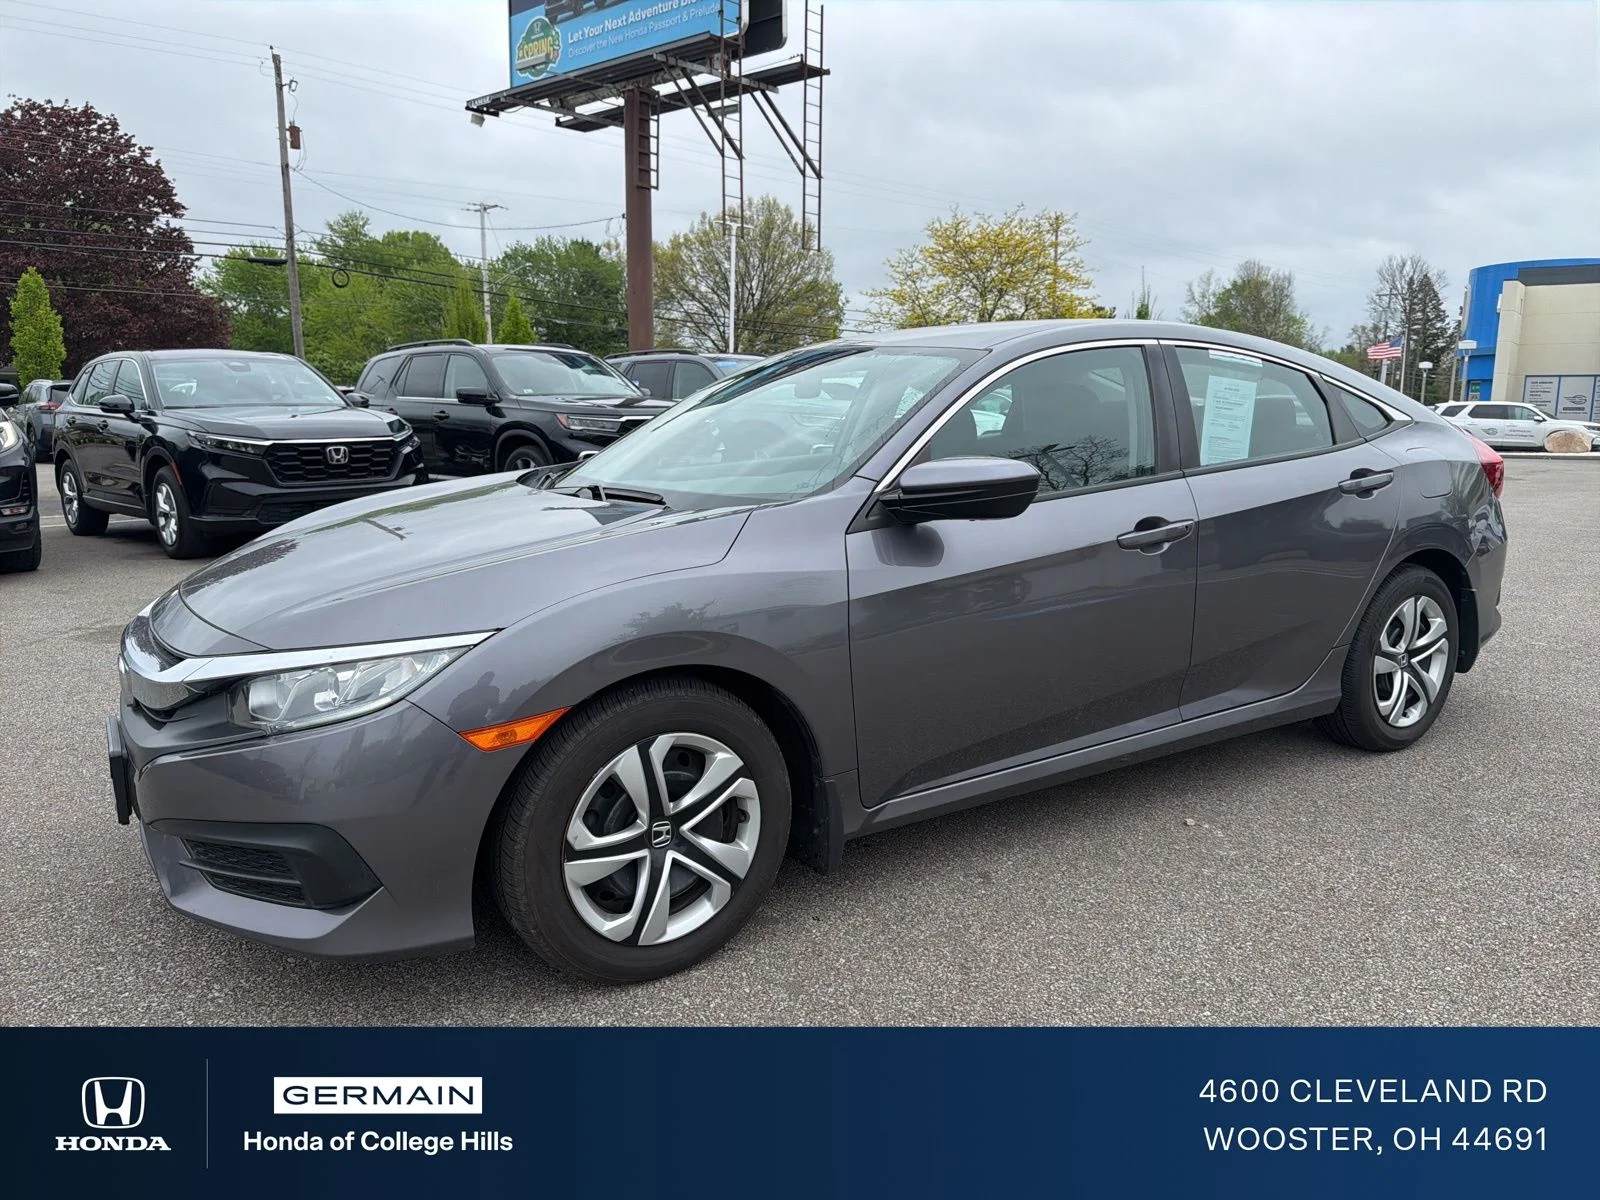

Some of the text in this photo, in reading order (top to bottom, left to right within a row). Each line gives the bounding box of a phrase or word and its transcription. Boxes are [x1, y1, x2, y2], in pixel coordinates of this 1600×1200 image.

[568, 31, 583, 44] Let
[583, 24, 603, 39] Your
[604, 15, 627, 32] Next
[628, 0, 679, 25] Adventure
[568, 43, 596, 58] Discover
[596, 39, 608, 49] the
[608, 34, 624, 45] New
[624, 26, 648, 40] Honda
[648, 15, 682, 32] Passport
